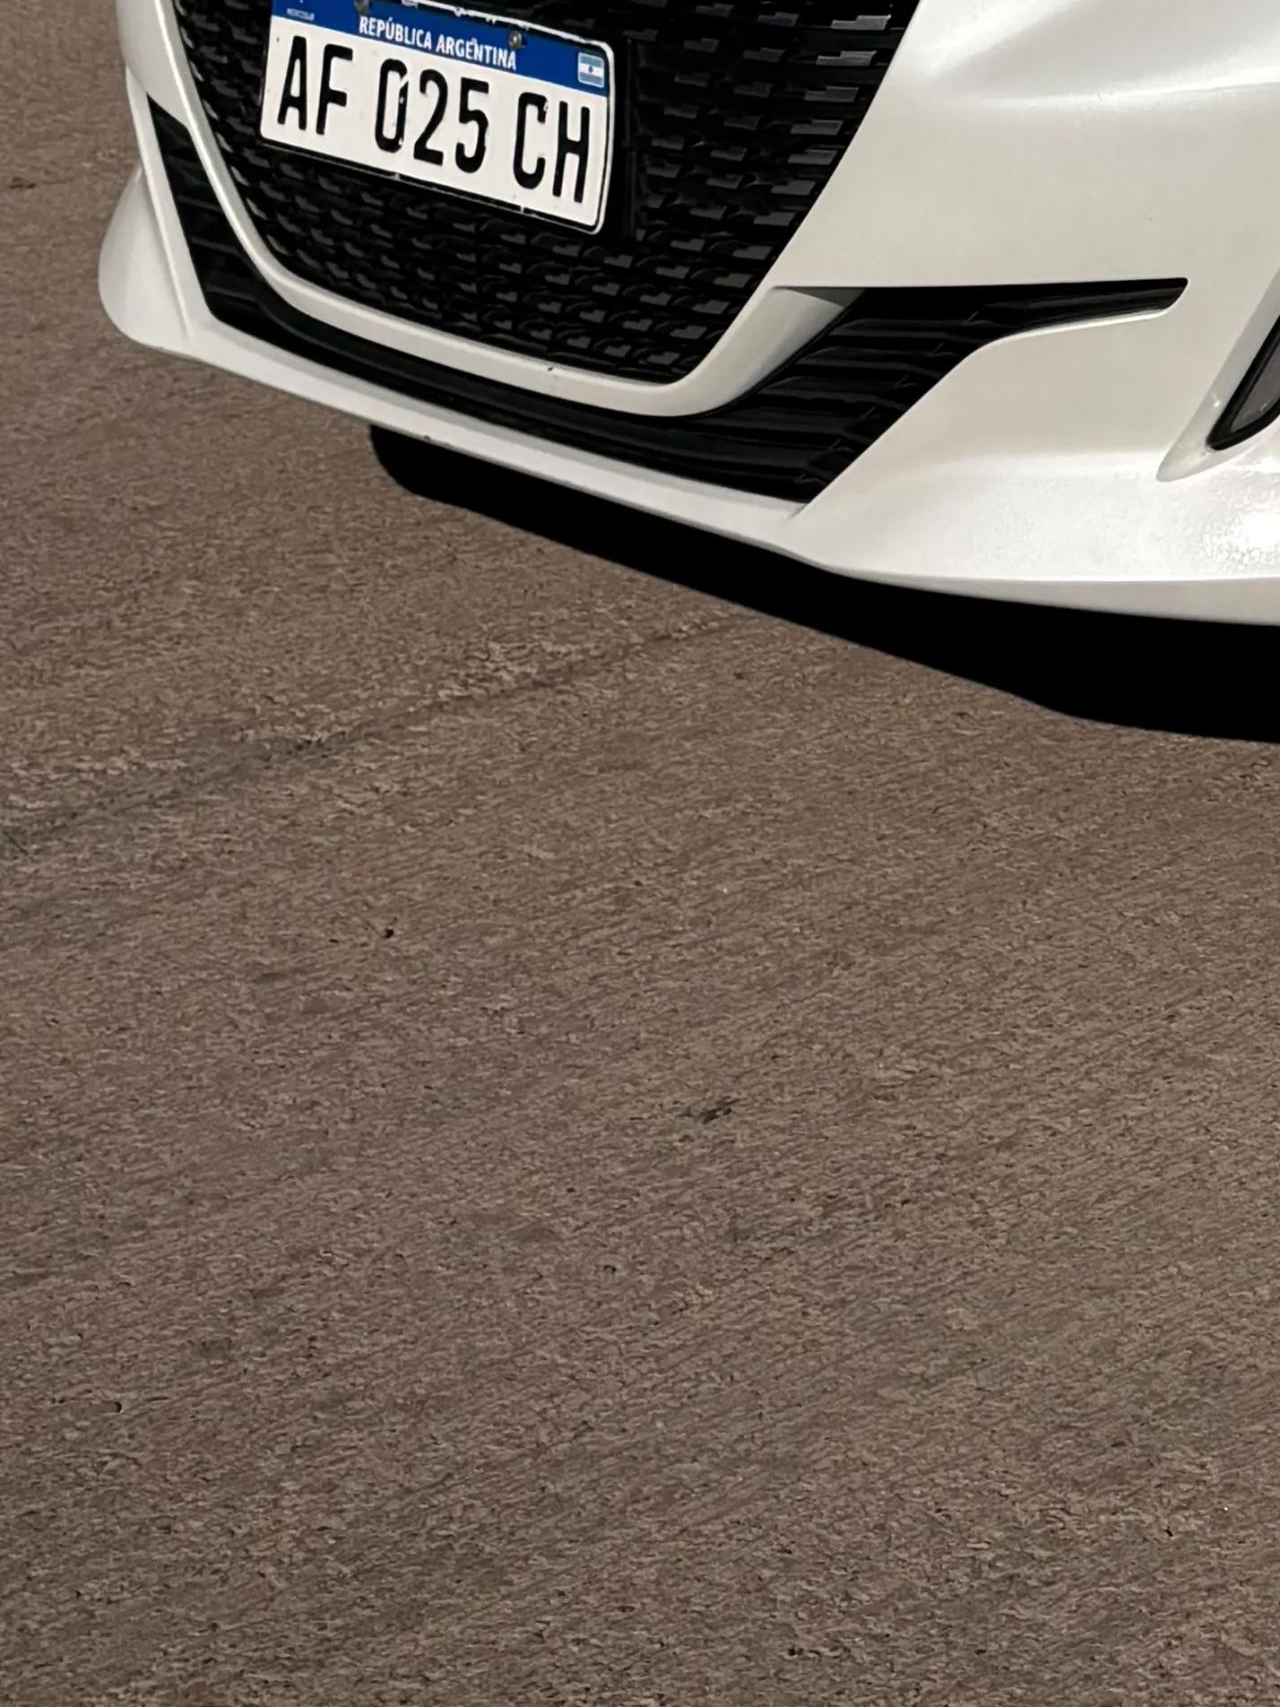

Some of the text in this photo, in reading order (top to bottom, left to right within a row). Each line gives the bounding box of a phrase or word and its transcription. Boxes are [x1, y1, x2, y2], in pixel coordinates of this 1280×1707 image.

[358, 16, 517, 71] REPÚBLICA ARGENTINA
[277, 35, 591, 204] AF 025 CH
